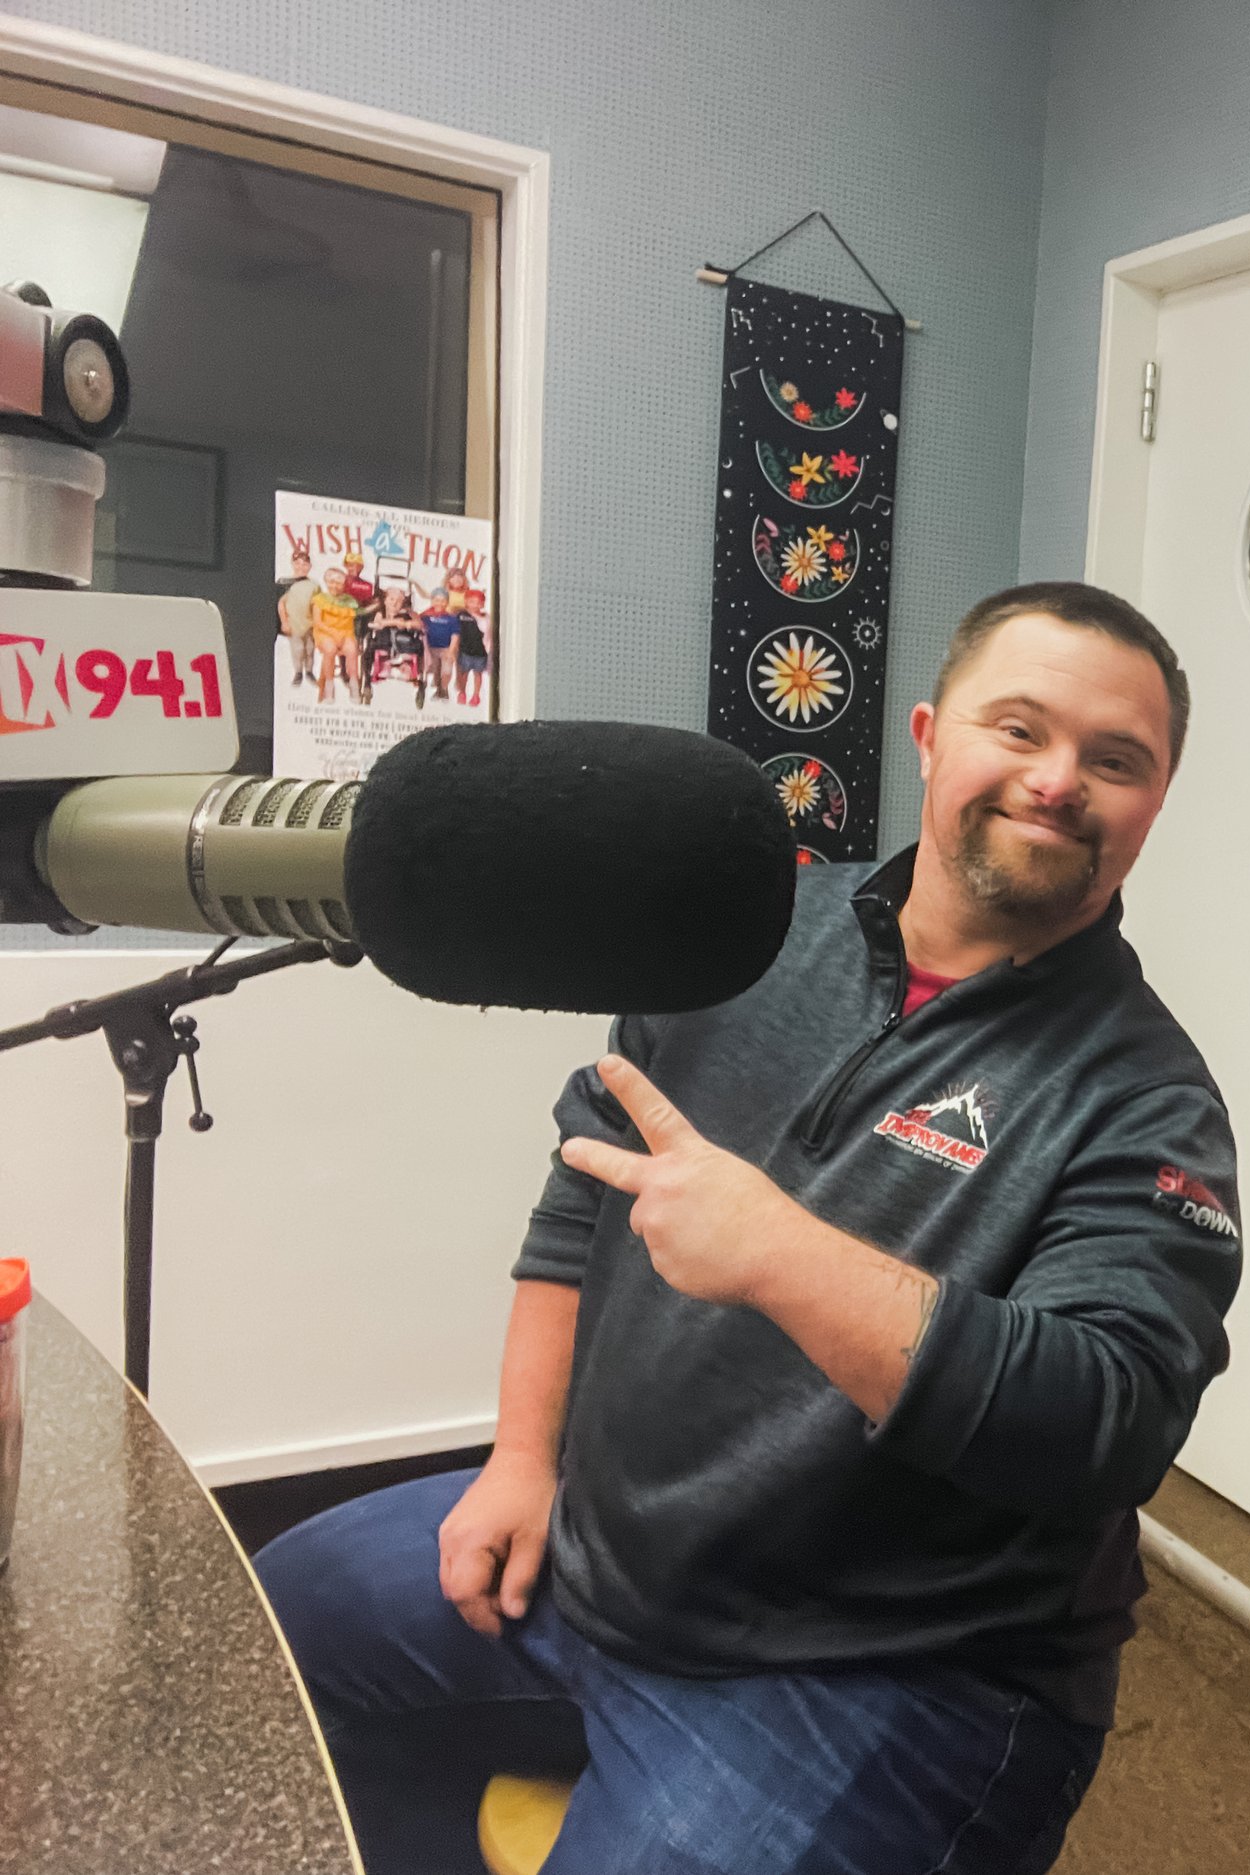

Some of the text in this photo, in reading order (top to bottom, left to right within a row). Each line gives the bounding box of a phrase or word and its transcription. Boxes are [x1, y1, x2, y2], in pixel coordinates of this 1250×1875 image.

[312, 501, 369, 517] CALLING
[282, 523, 363, 555] WISH
[374, 531, 390, 552] a
[405, 531, 487, 582] THON
[75, 648, 223, 719] 94.1
